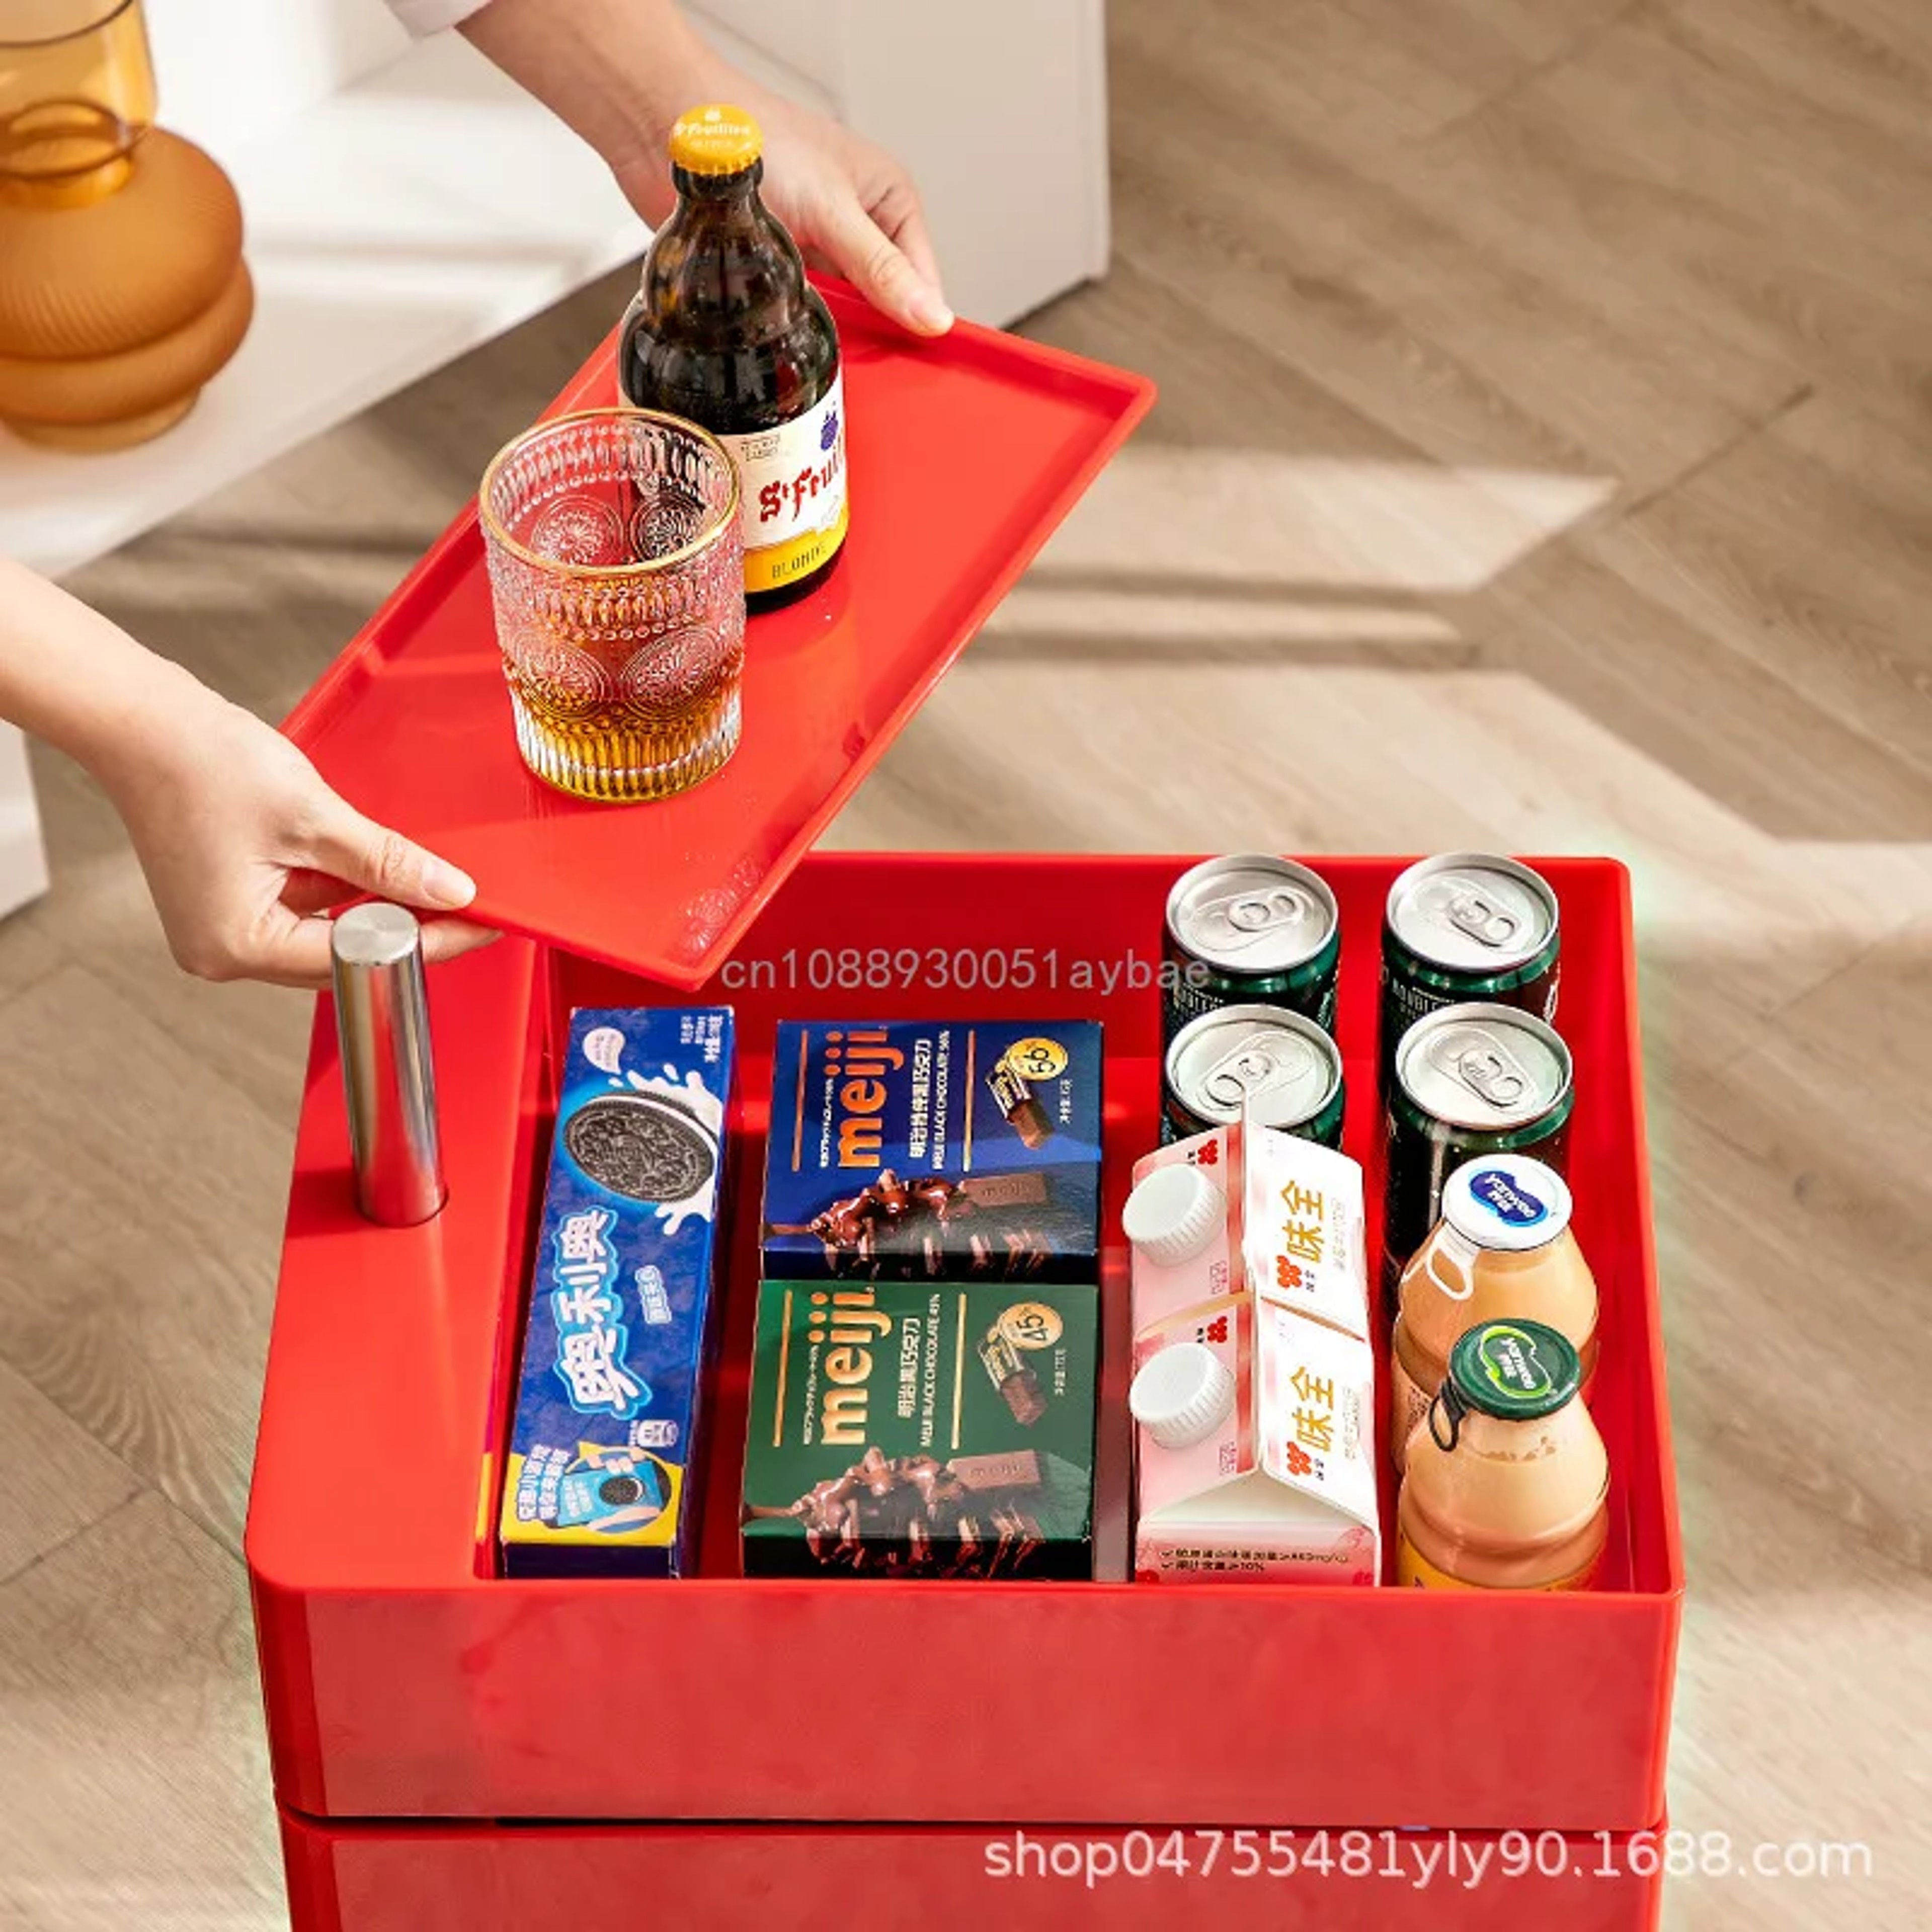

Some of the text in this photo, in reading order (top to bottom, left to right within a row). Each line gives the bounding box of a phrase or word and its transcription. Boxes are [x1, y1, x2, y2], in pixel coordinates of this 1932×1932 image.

[824, 1030, 904, 1167] meiji
[1279, 1179, 1325, 1264] 味全
[559, 1209, 639, 1410] 奥利奥
[925, 1317, 940, 1380] CHOCOLATE
[808, 1292, 893, 1445] meiji
[898, 1318, 921, 1418] 明治黑巧克力
[1290, 1365, 1334, 1453] 味全
